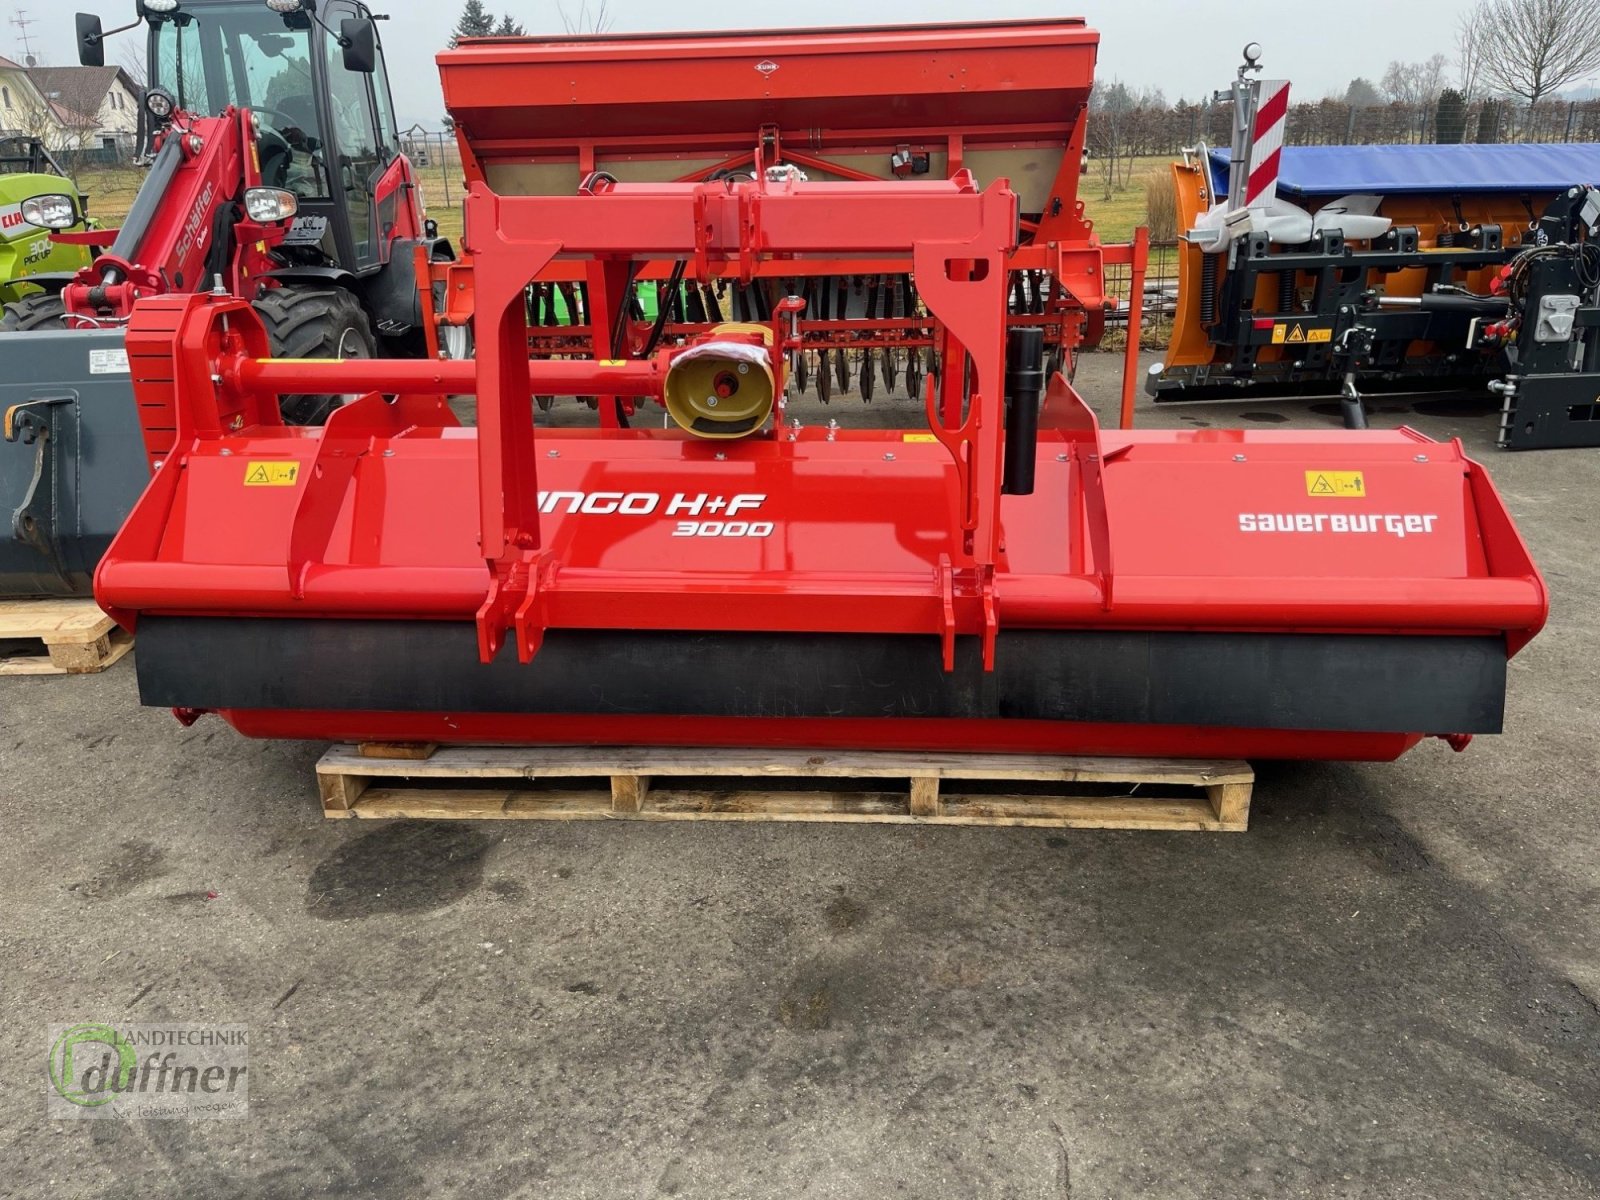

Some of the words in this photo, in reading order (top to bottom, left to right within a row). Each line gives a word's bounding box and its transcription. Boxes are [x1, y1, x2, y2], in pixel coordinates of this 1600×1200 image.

[175, 180, 213, 268] Schäffer
[23, 254, 40, 267] PICK
[40, 249, 52, 261] UP
[665, 493, 767, 516] H+F
[671, 521, 775, 537] 3000
[1238, 513, 1438, 538] sauerburger
